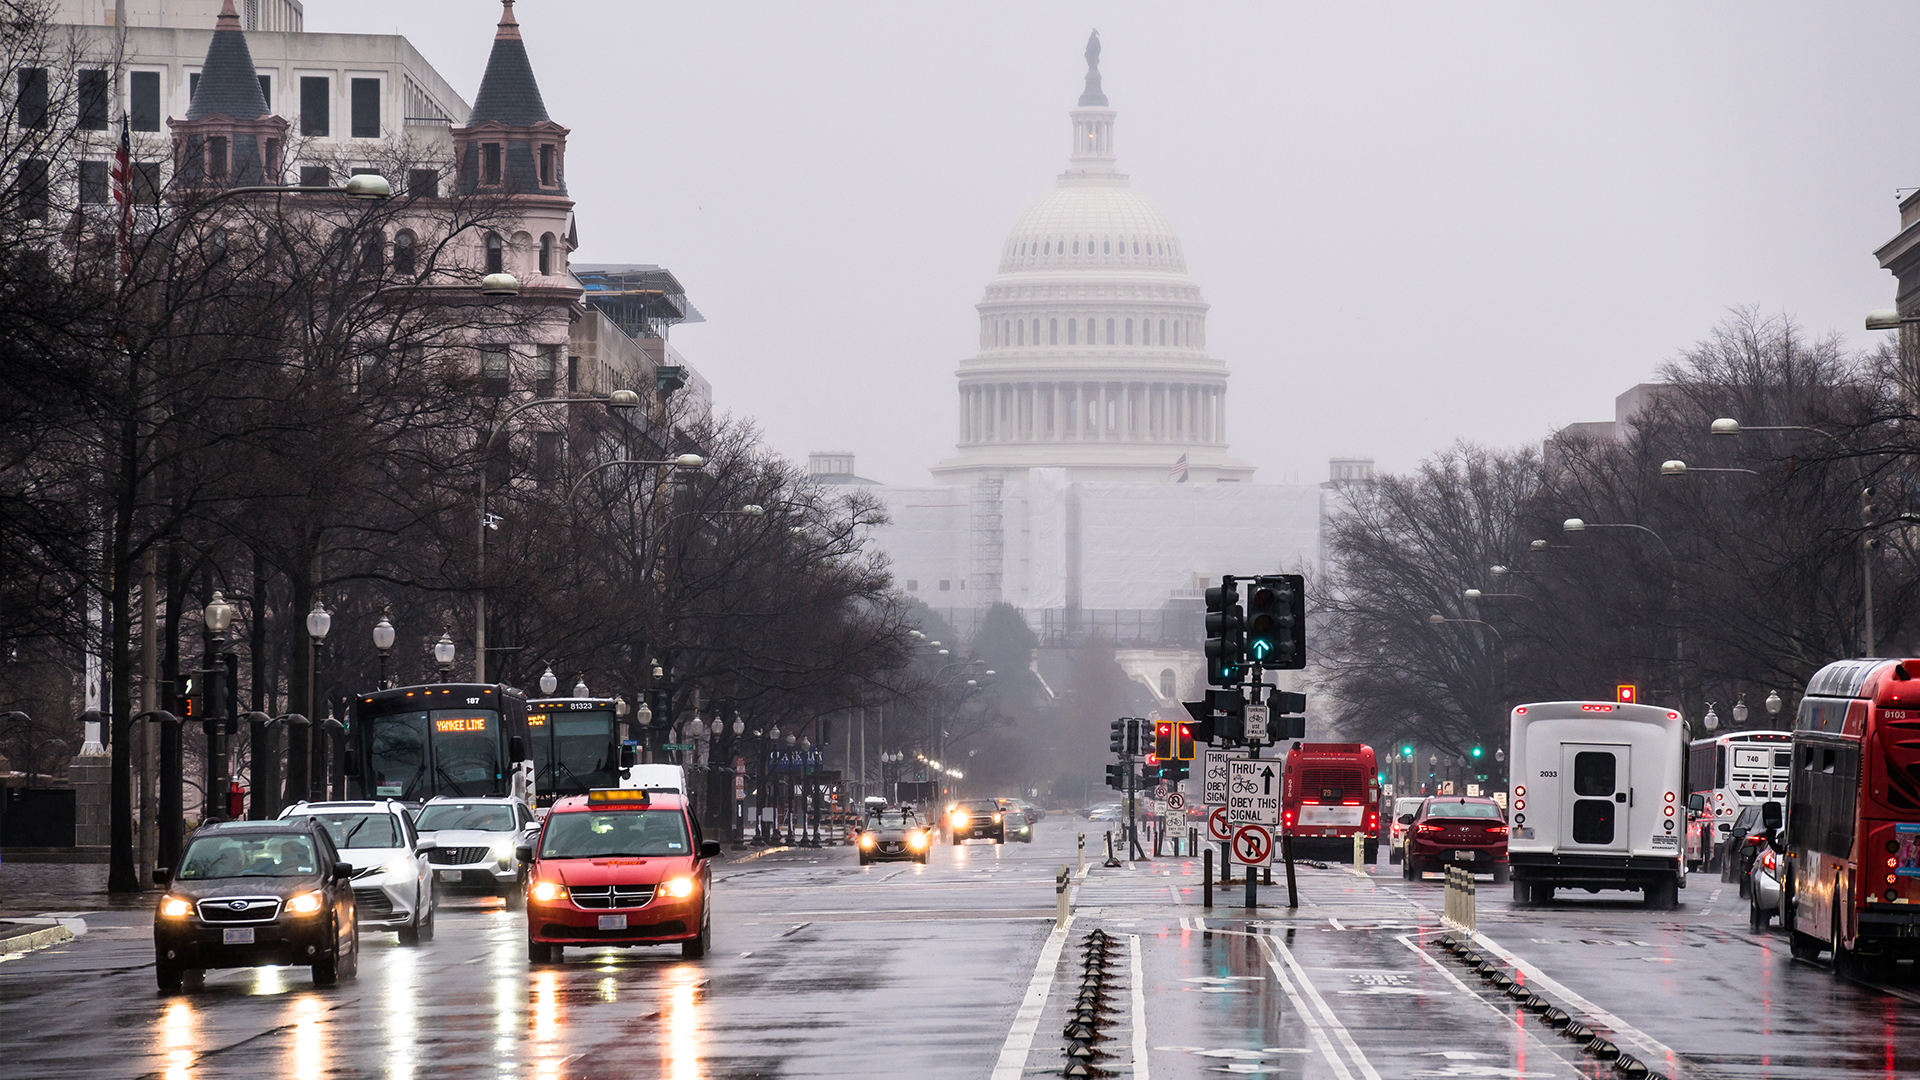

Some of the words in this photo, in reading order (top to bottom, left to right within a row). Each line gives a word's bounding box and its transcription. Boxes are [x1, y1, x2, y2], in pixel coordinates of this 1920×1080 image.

[1885, 710, 1906, 719] 8103
[436, 720, 465, 731] YANKEE
[466, 718, 485, 730] LINE
[1232, 763, 1256, 774] THRU
[1207, 782, 1226, 790] OBEY
[1231, 797, 1254, 808] OBEY
[1257, 798, 1277, 808] THIS
[1230, 809, 1262, 821] SIGNAL
